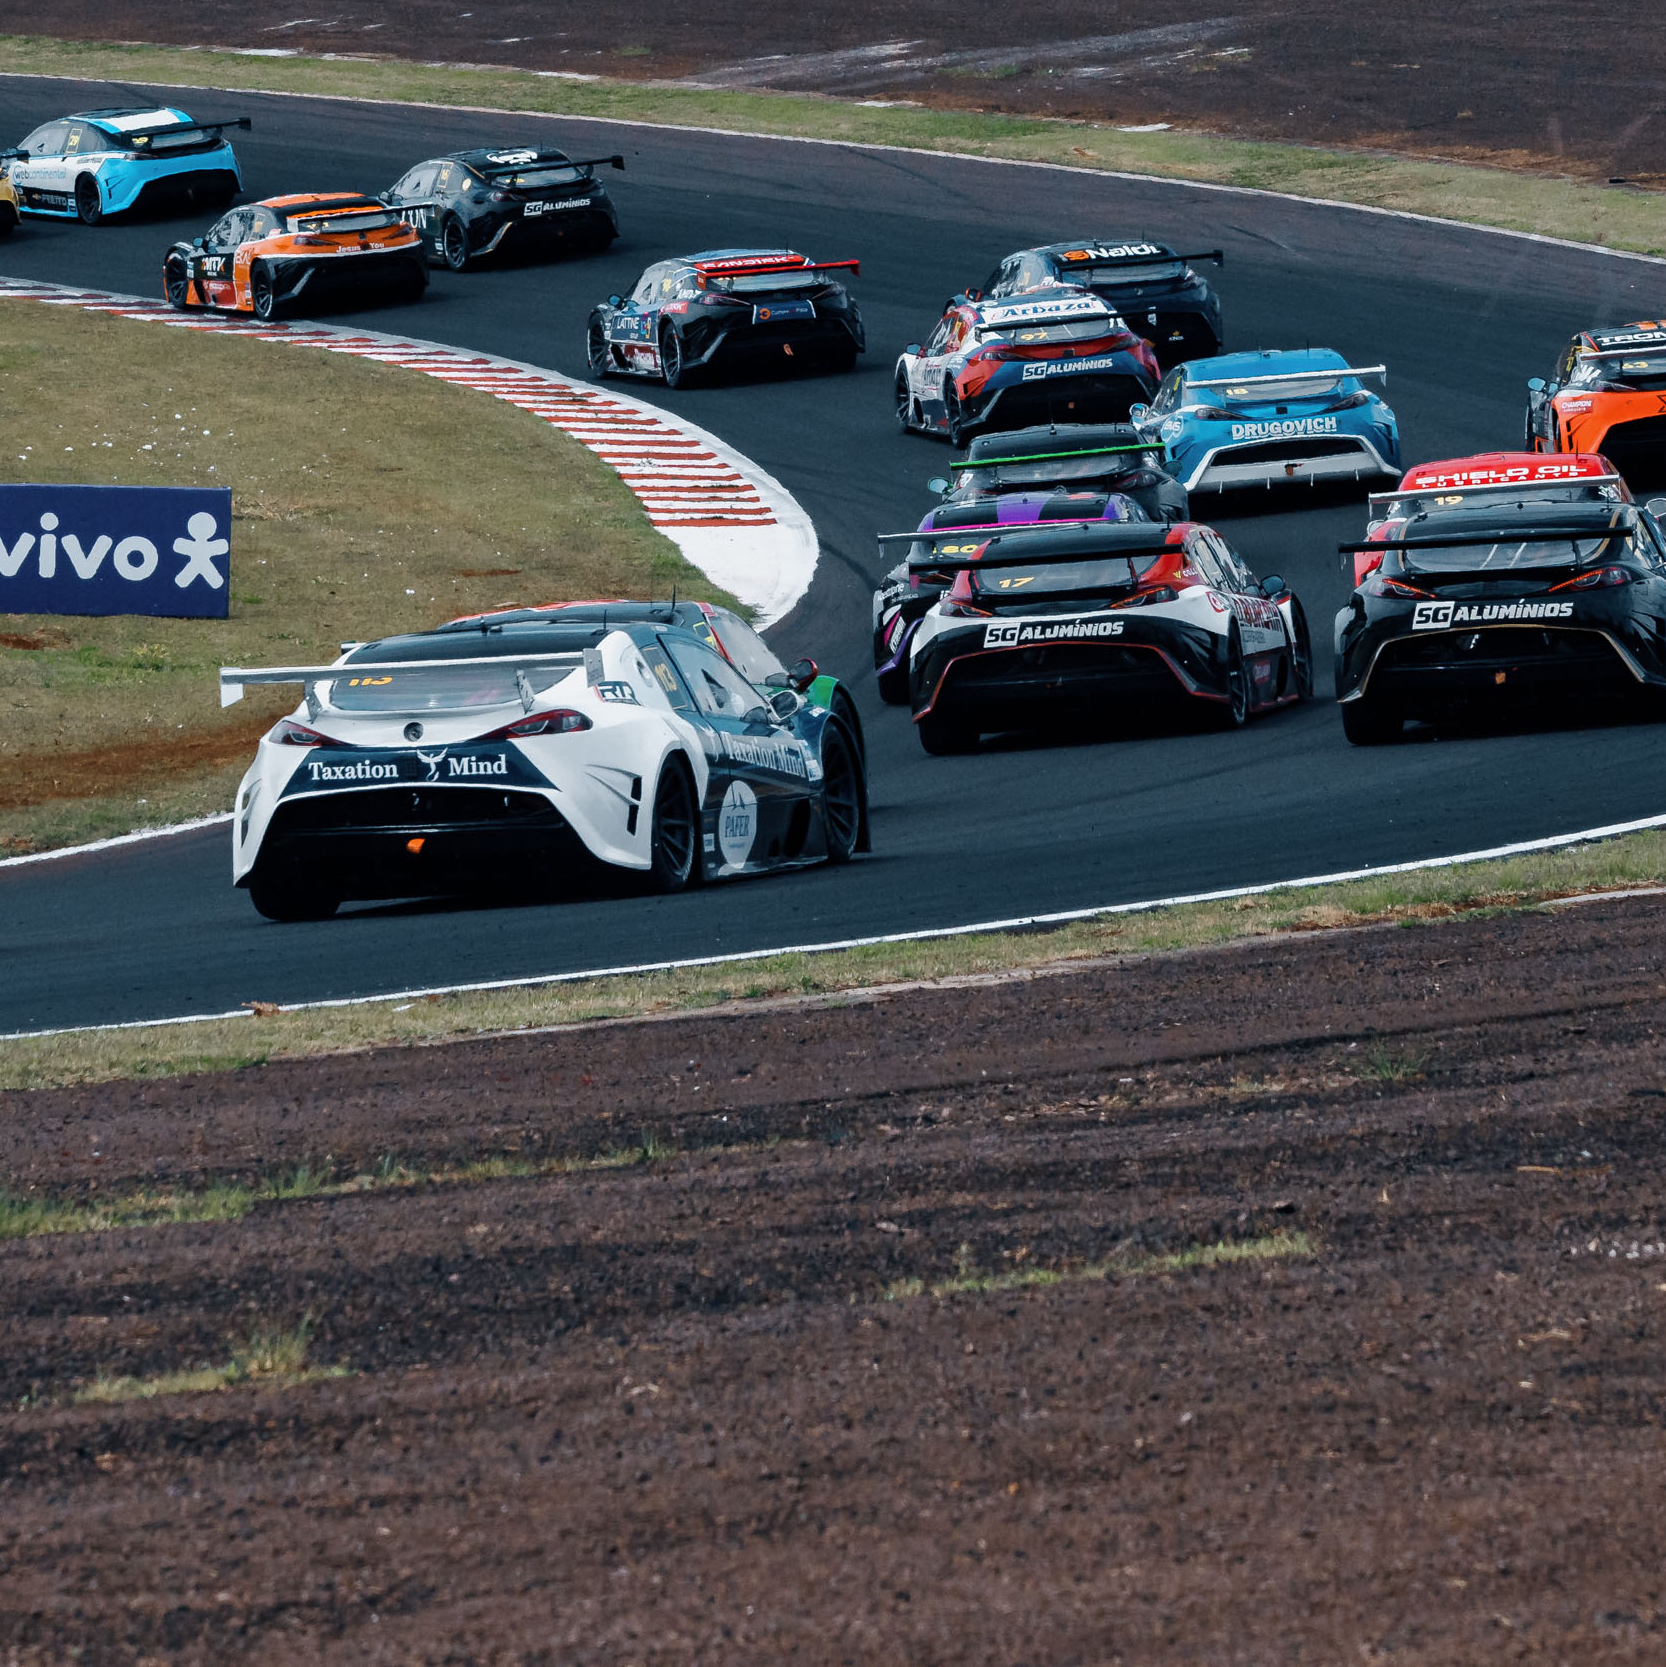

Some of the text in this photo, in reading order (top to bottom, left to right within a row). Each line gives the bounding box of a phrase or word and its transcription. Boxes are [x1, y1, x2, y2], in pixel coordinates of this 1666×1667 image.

[1024, 363, 1046, 378] SG
[1231, 416, 1337, 439] DRUGOVICH
[1415, 464, 1588, 485] SHIELD OIL
[1434, 495, 1464, 506] 19
[998, 576, 1035, 589] 17
[1416, 598, 1574, 625] SG ALUMÍNIOS
[987, 618, 1125, 645] SG ALUMÍNIOS
[720, 731, 776, 768] Taxation
[308, 753, 508, 782] Taxation Mind
